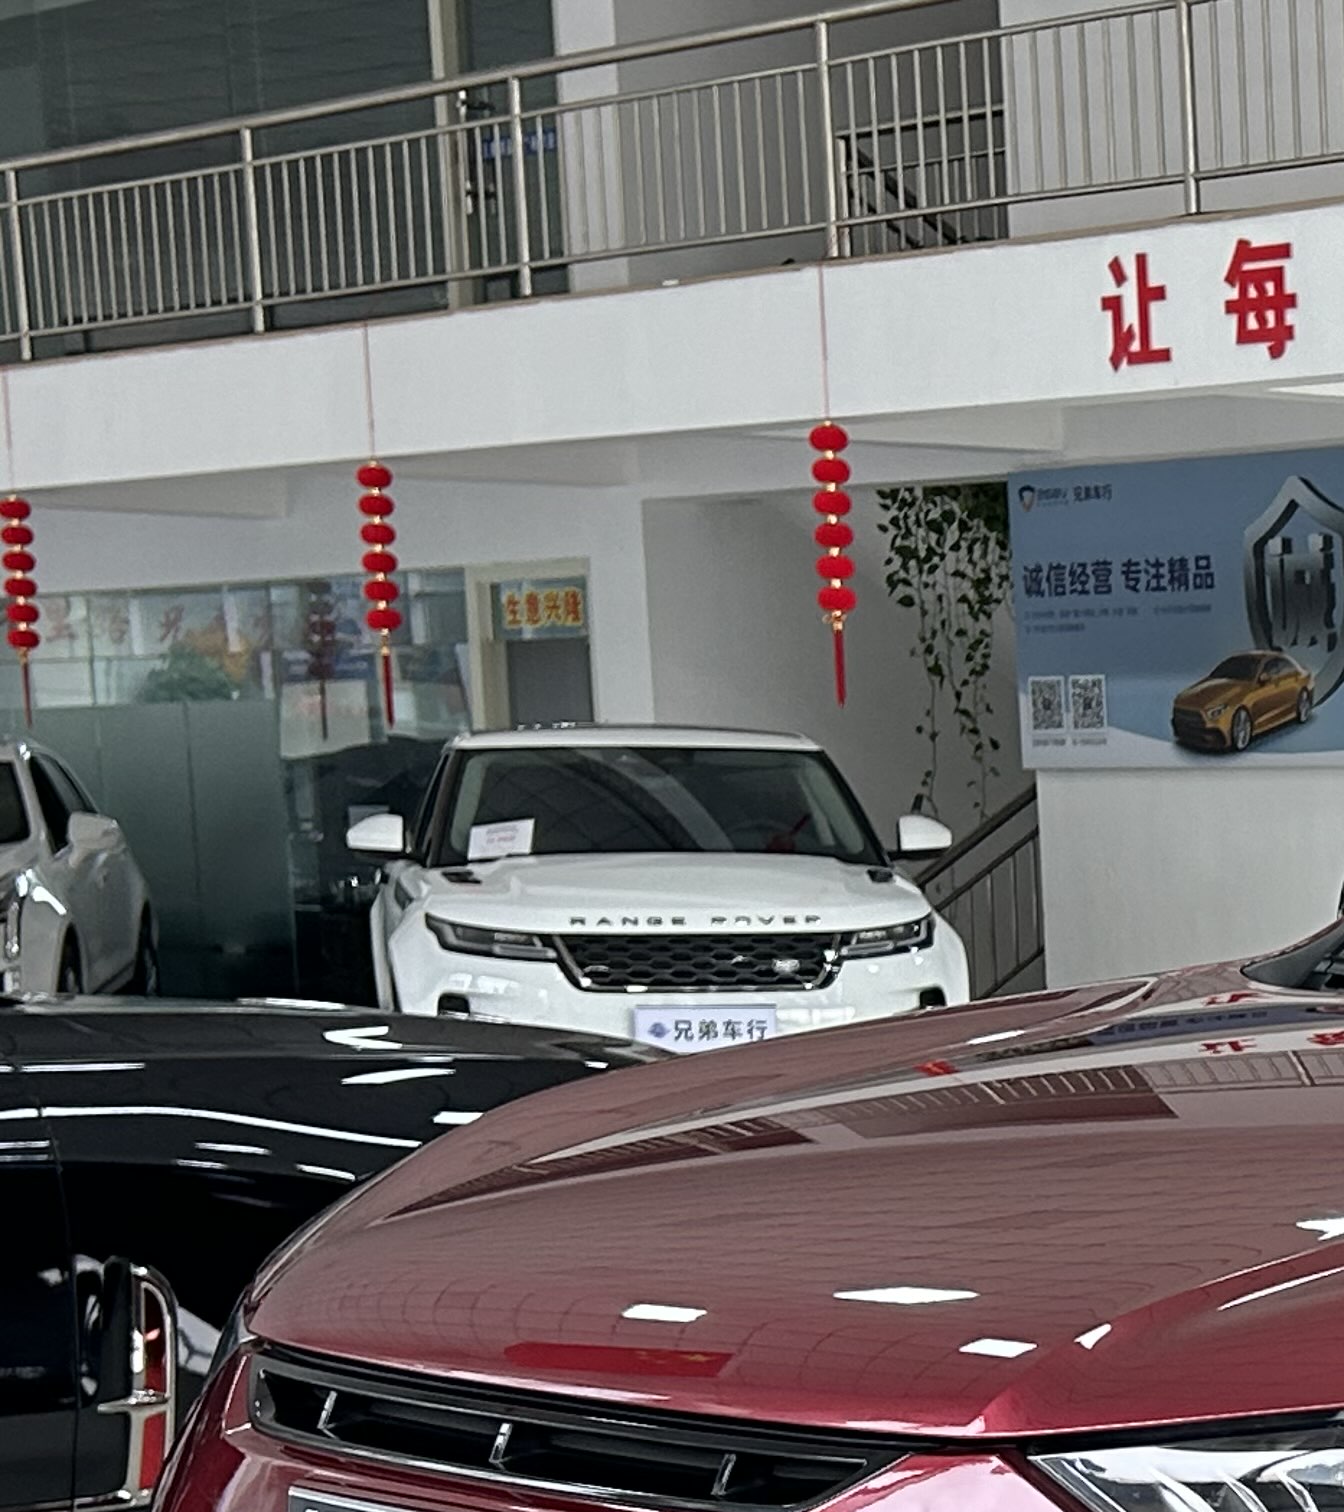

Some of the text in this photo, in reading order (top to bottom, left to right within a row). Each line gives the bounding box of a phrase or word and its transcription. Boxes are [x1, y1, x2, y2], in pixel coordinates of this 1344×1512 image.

[1023, 555, 1215, 598] 诚信经营 专注精品
[504, 588, 583, 628] 生意兴隆
[570, 916, 686, 926] RANGE
[673, 1019, 768, 1041] 兄弟车行
